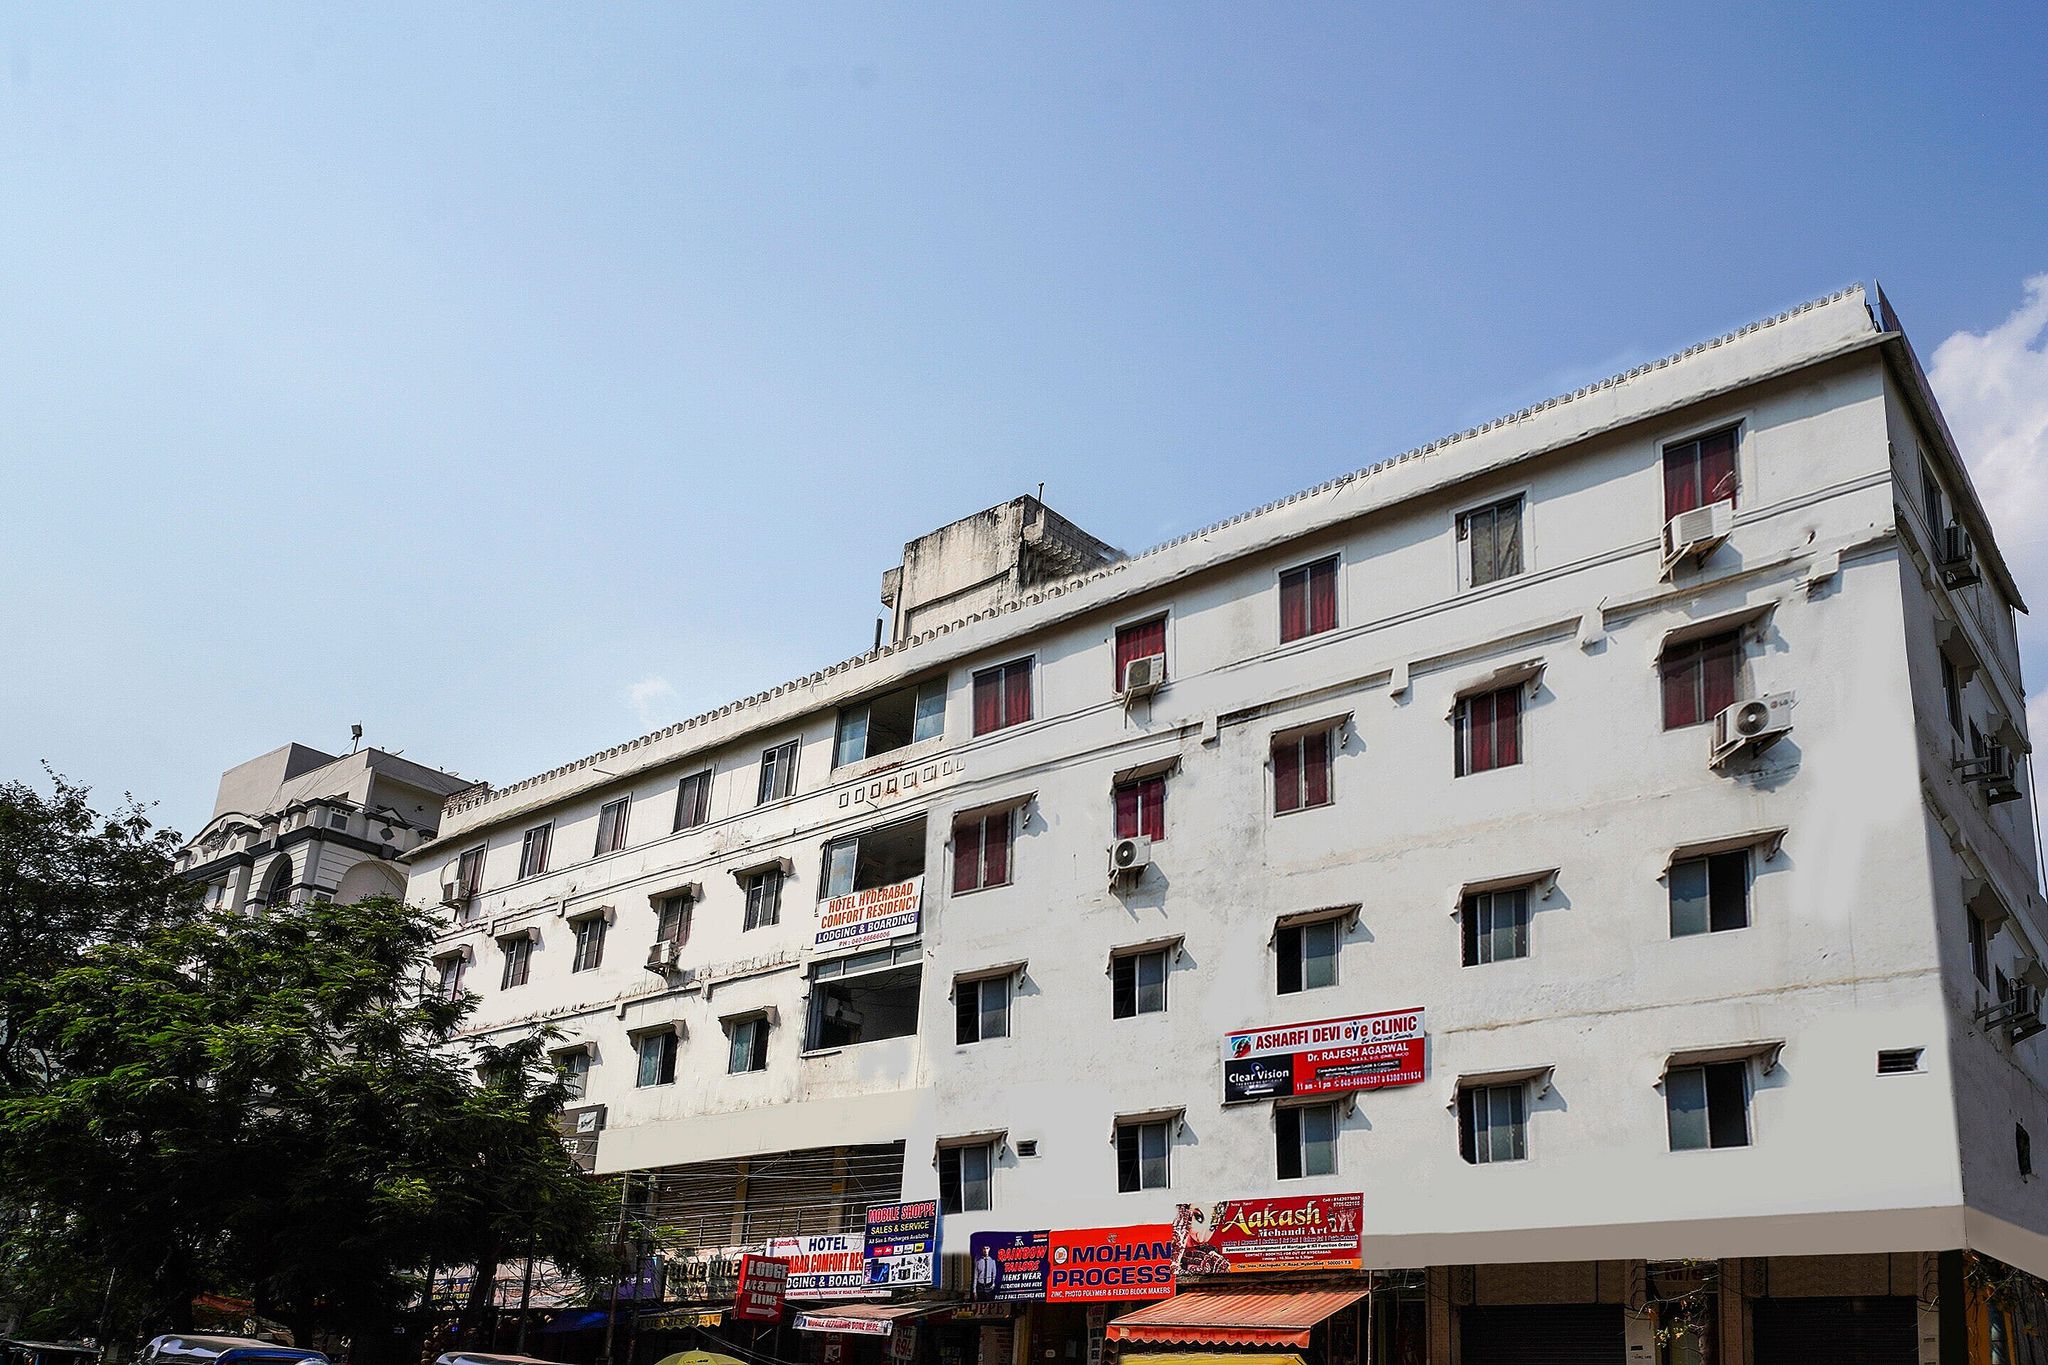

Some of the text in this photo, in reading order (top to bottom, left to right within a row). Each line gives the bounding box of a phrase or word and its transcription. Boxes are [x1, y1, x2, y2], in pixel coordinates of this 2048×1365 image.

[828, 882, 913, 914] HOTEL HYDERABAD
[821, 895, 918, 929] COMFORT RESIDENCY
[817, 913, 915, 942] LODGING & BOARDING
[1255, 1016, 1417, 1050] ASHARFI DEVI eye CLINIC
[1307, 1053, 1320, 1062] Dr.
[1322, 1048, 1359, 1061] RAJESH
[1361, 1043, 1409, 1057] AGARWAL
[1228, 1072, 1256, 1083] Clear
[1257, 1068, 1290, 1080] Vision
[867, 1201, 935, 1224] MOBILE SHOPPE
[1221, 1200, 1323, 1236] Aakash
[870, 1220, 930, 1235] SALES & SERVICE
[1257, 1226, 1328, 1238] Mehandi Art
[809, 1237, 848, 1251] HOTEL
[998, 1245, 1048, 1262] RAINBOW
[1071, 1242, 1172, 1263] MOHAN
[708, 1258, 741, 1279] NILE
[748, 1260, 789, 1280] LODGE
[811, 1252, 849, 1273] COMFORT
[1004, 1260, 1041, 1273] TAILORS
[786, 1277, 816, 1288] DGING
[818, 1276, 825, 1287] &
[1022, 1272, 1042, 1280] WEAR
[1051, 1264, 1172, 1287] PROCESS
[757, 1281, 765, 1292] &
[1082, 1289, 1107, 1297] POLYMER
[1148, 1286, 1171, 1295] MAKERS
